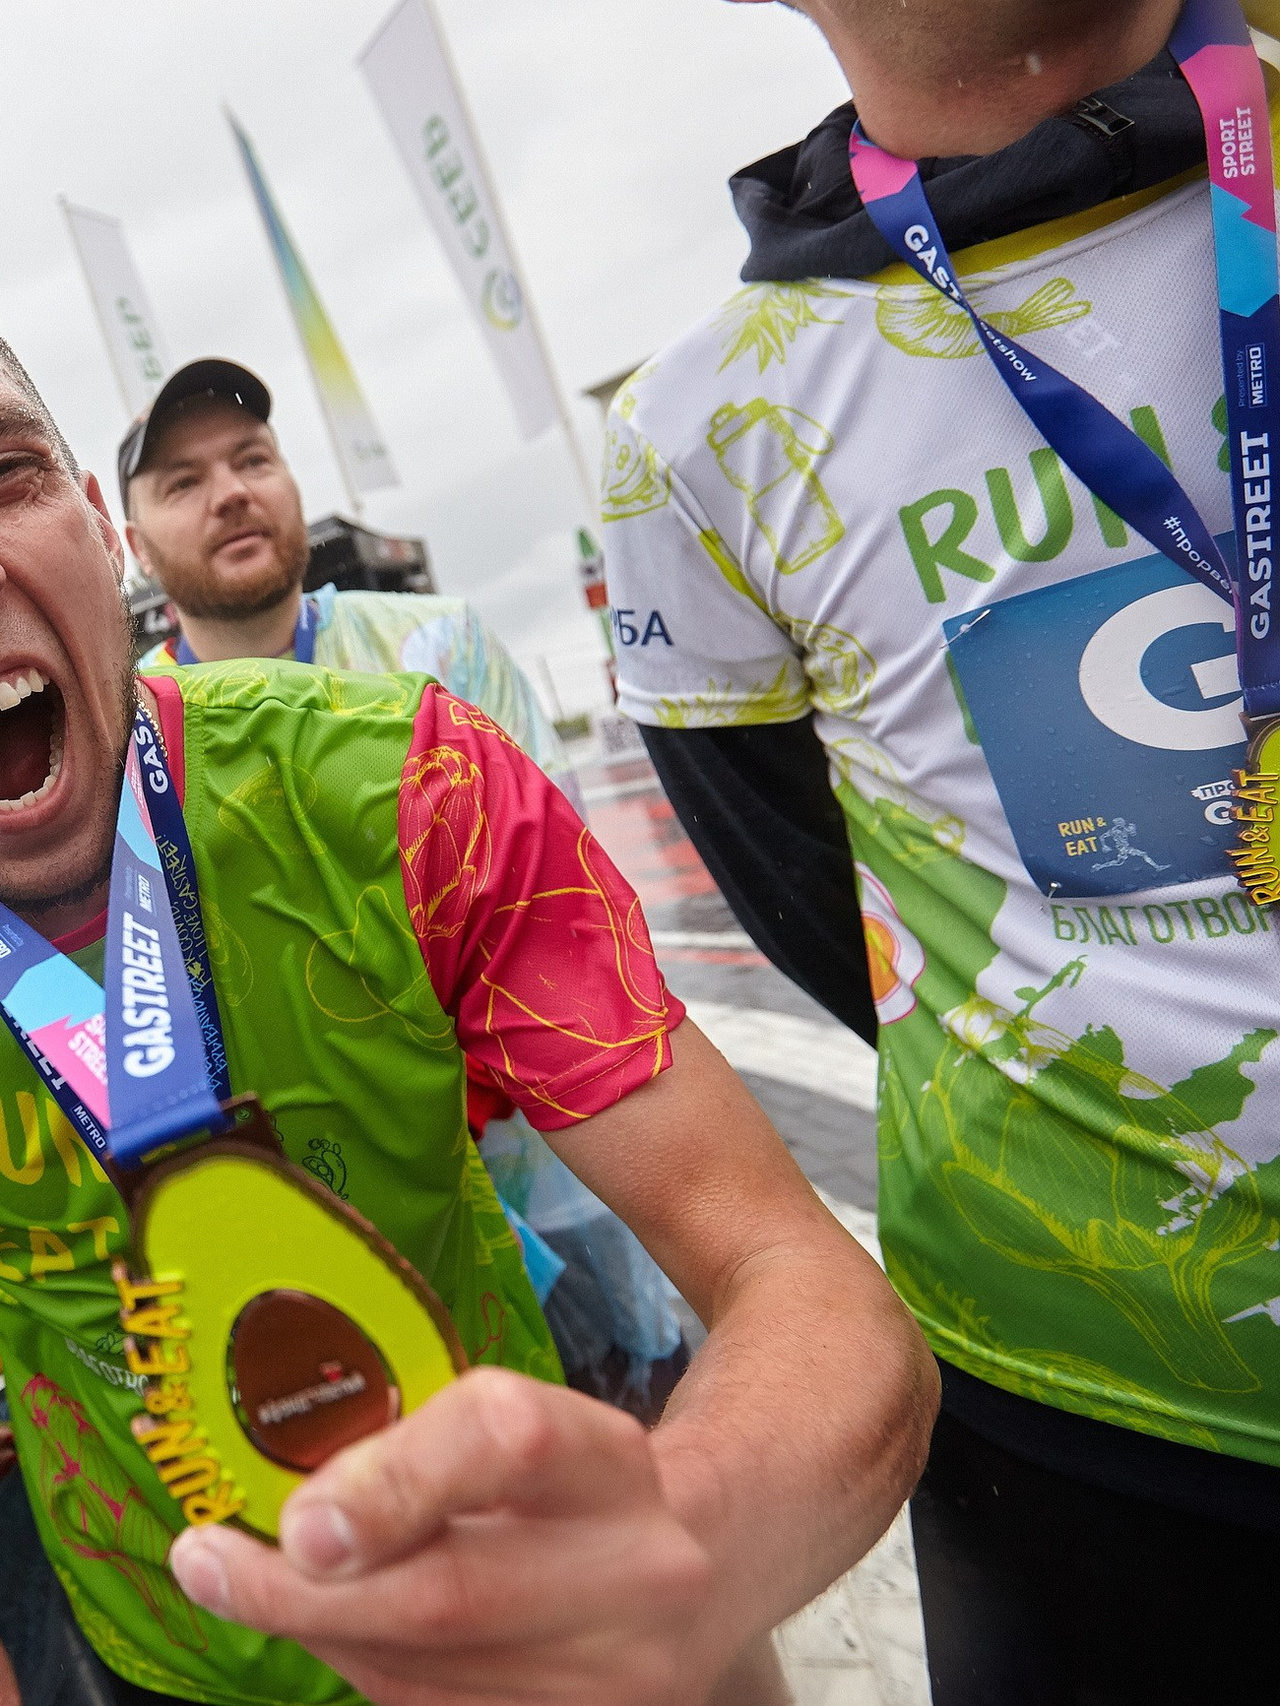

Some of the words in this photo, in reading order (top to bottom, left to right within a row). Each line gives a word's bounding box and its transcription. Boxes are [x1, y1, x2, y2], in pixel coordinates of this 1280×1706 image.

[1220, 119, 1238, 178] SPORT
[1236, 107, 1255, 176] STREET
[1250, 346, 1264, 405] METRO
[1240, 431, 1271, 640] GASTREET
[1232, 769, 1280, 823] EAT
[1058, 818, 1095, 838] RUN
[1096, 816, 1107, 828] &
[1065, 837, 1098, 857] EAT
[138, 875, 155, 911] METRO
[122, 912, 176, 1078] GASTREET
[72, 1104, 107, 1150] METRO
[119, 1268, 192, 1378] EAT
